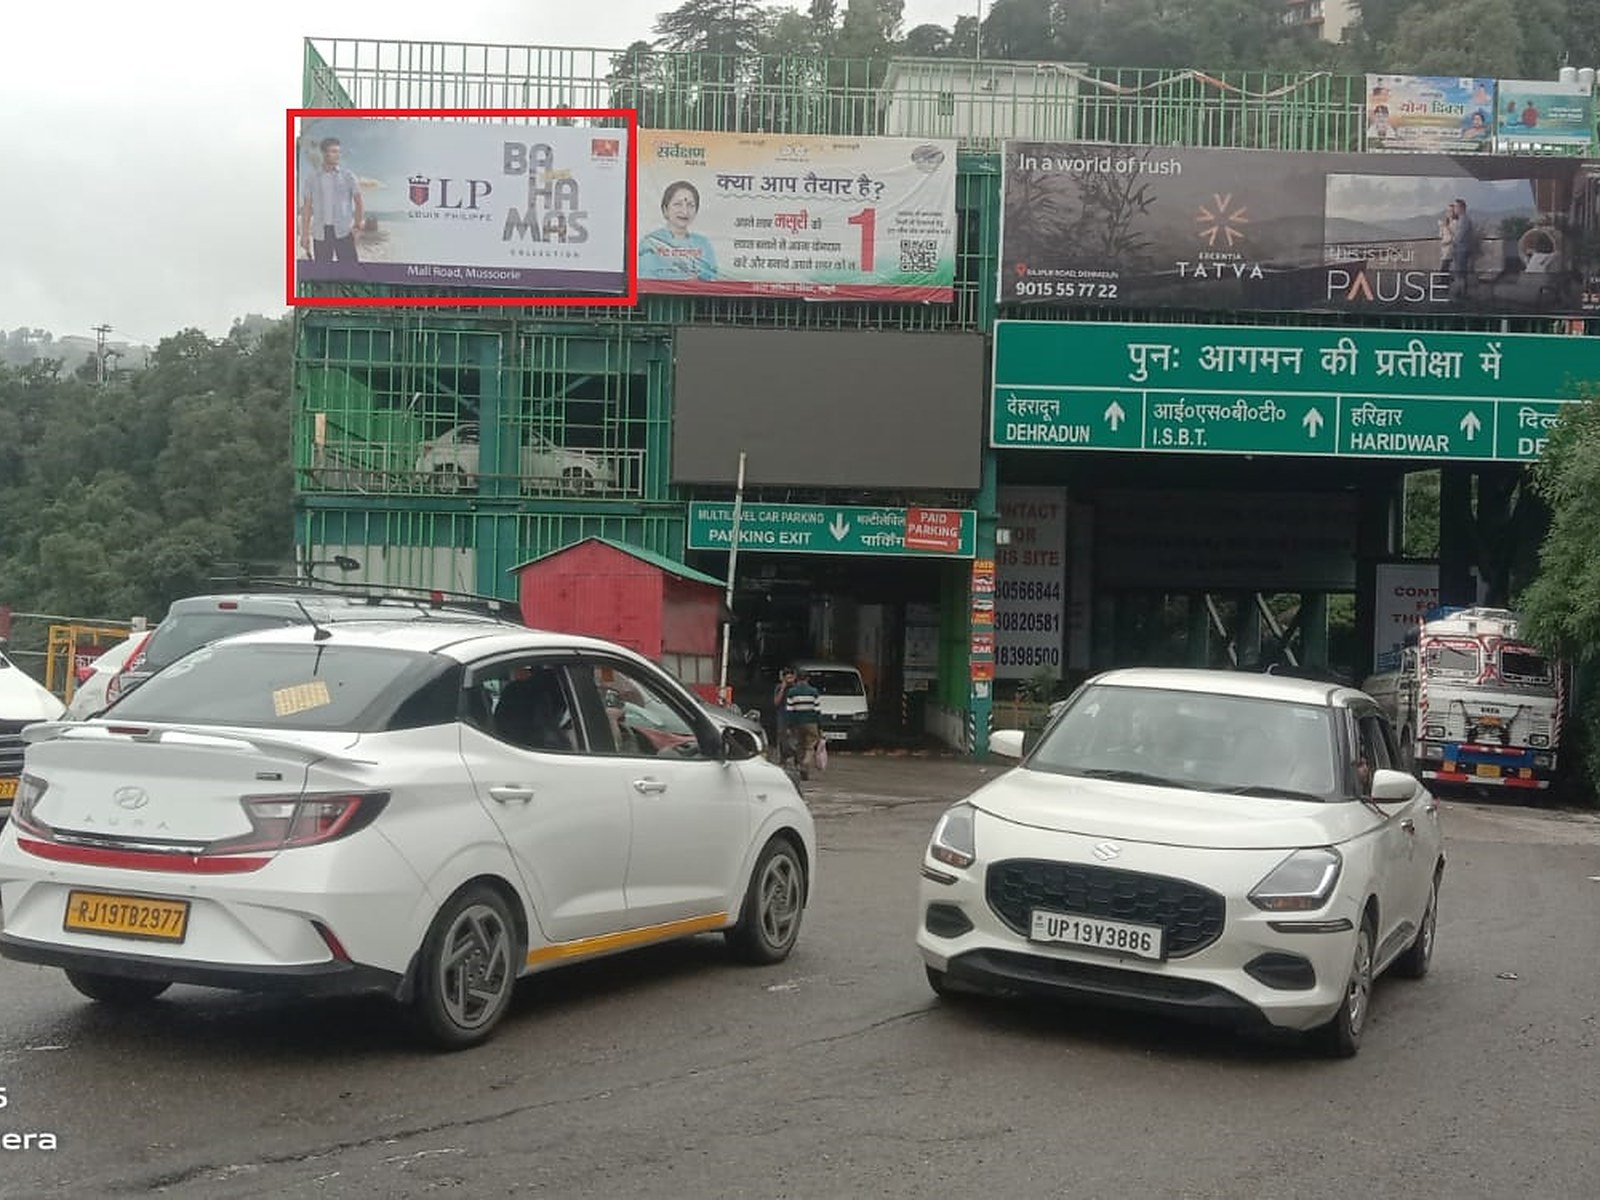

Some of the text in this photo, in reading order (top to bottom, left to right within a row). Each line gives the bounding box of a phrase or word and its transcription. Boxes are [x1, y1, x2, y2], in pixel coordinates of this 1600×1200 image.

[503, 141, 554, 176] BA
[1019, 153, 1182, 175] In a world of rush
[439, 178, 492, 209] LP
[528, 176, 579, 210] HA
[717, 172, 886, 200] क्या आप तैयार है?
[502, 207, 591, 243] MAS
[774, 209, 808, 235] मसूरी
[848, 207, 876, 272] 1
[407, 265, 522, 280] Mall Road, Mussoorie
[1175, 261, 1264, 279] TATVA
[1016, 281, 1118, 298] 9015 55 77 22
[1327, 270, 1451, 303] PAUSE
[1198, 343, 1302, 377] आगमन
[1320, 337, 1358, 377] की
[1375, 339, 1463, 379] प्रतीक्षा
[1480, 342, 1502, 380] में
[1007, 393, 1060, 421] देहरादून
[1351, 402, 1403, 429] हरिद्वार
[1006, 423, 1090, 444] DEHRADUN
[1153, 427, 1207, 447] I.S.B.T.
[1350, 433, 1450, 452] HARIDWAR
[698, 509, 825, 524] MULTILVEL CAR PARKING
[920, 512, 947, 523] PAID
[779, 532, 812, 546] EXIT
[908, 524, 958, 537] PARKING
[1015, 526, 1037, 543] OR
[1022, 550, 1060, 566] SITE
[1394, 586, 1440, 597] CONT
[84, 814, 169, 831] AURA
[78, 901, 184, 933] RJ19TB2977
[1047, 918, 1152, 951] UP19V3886
